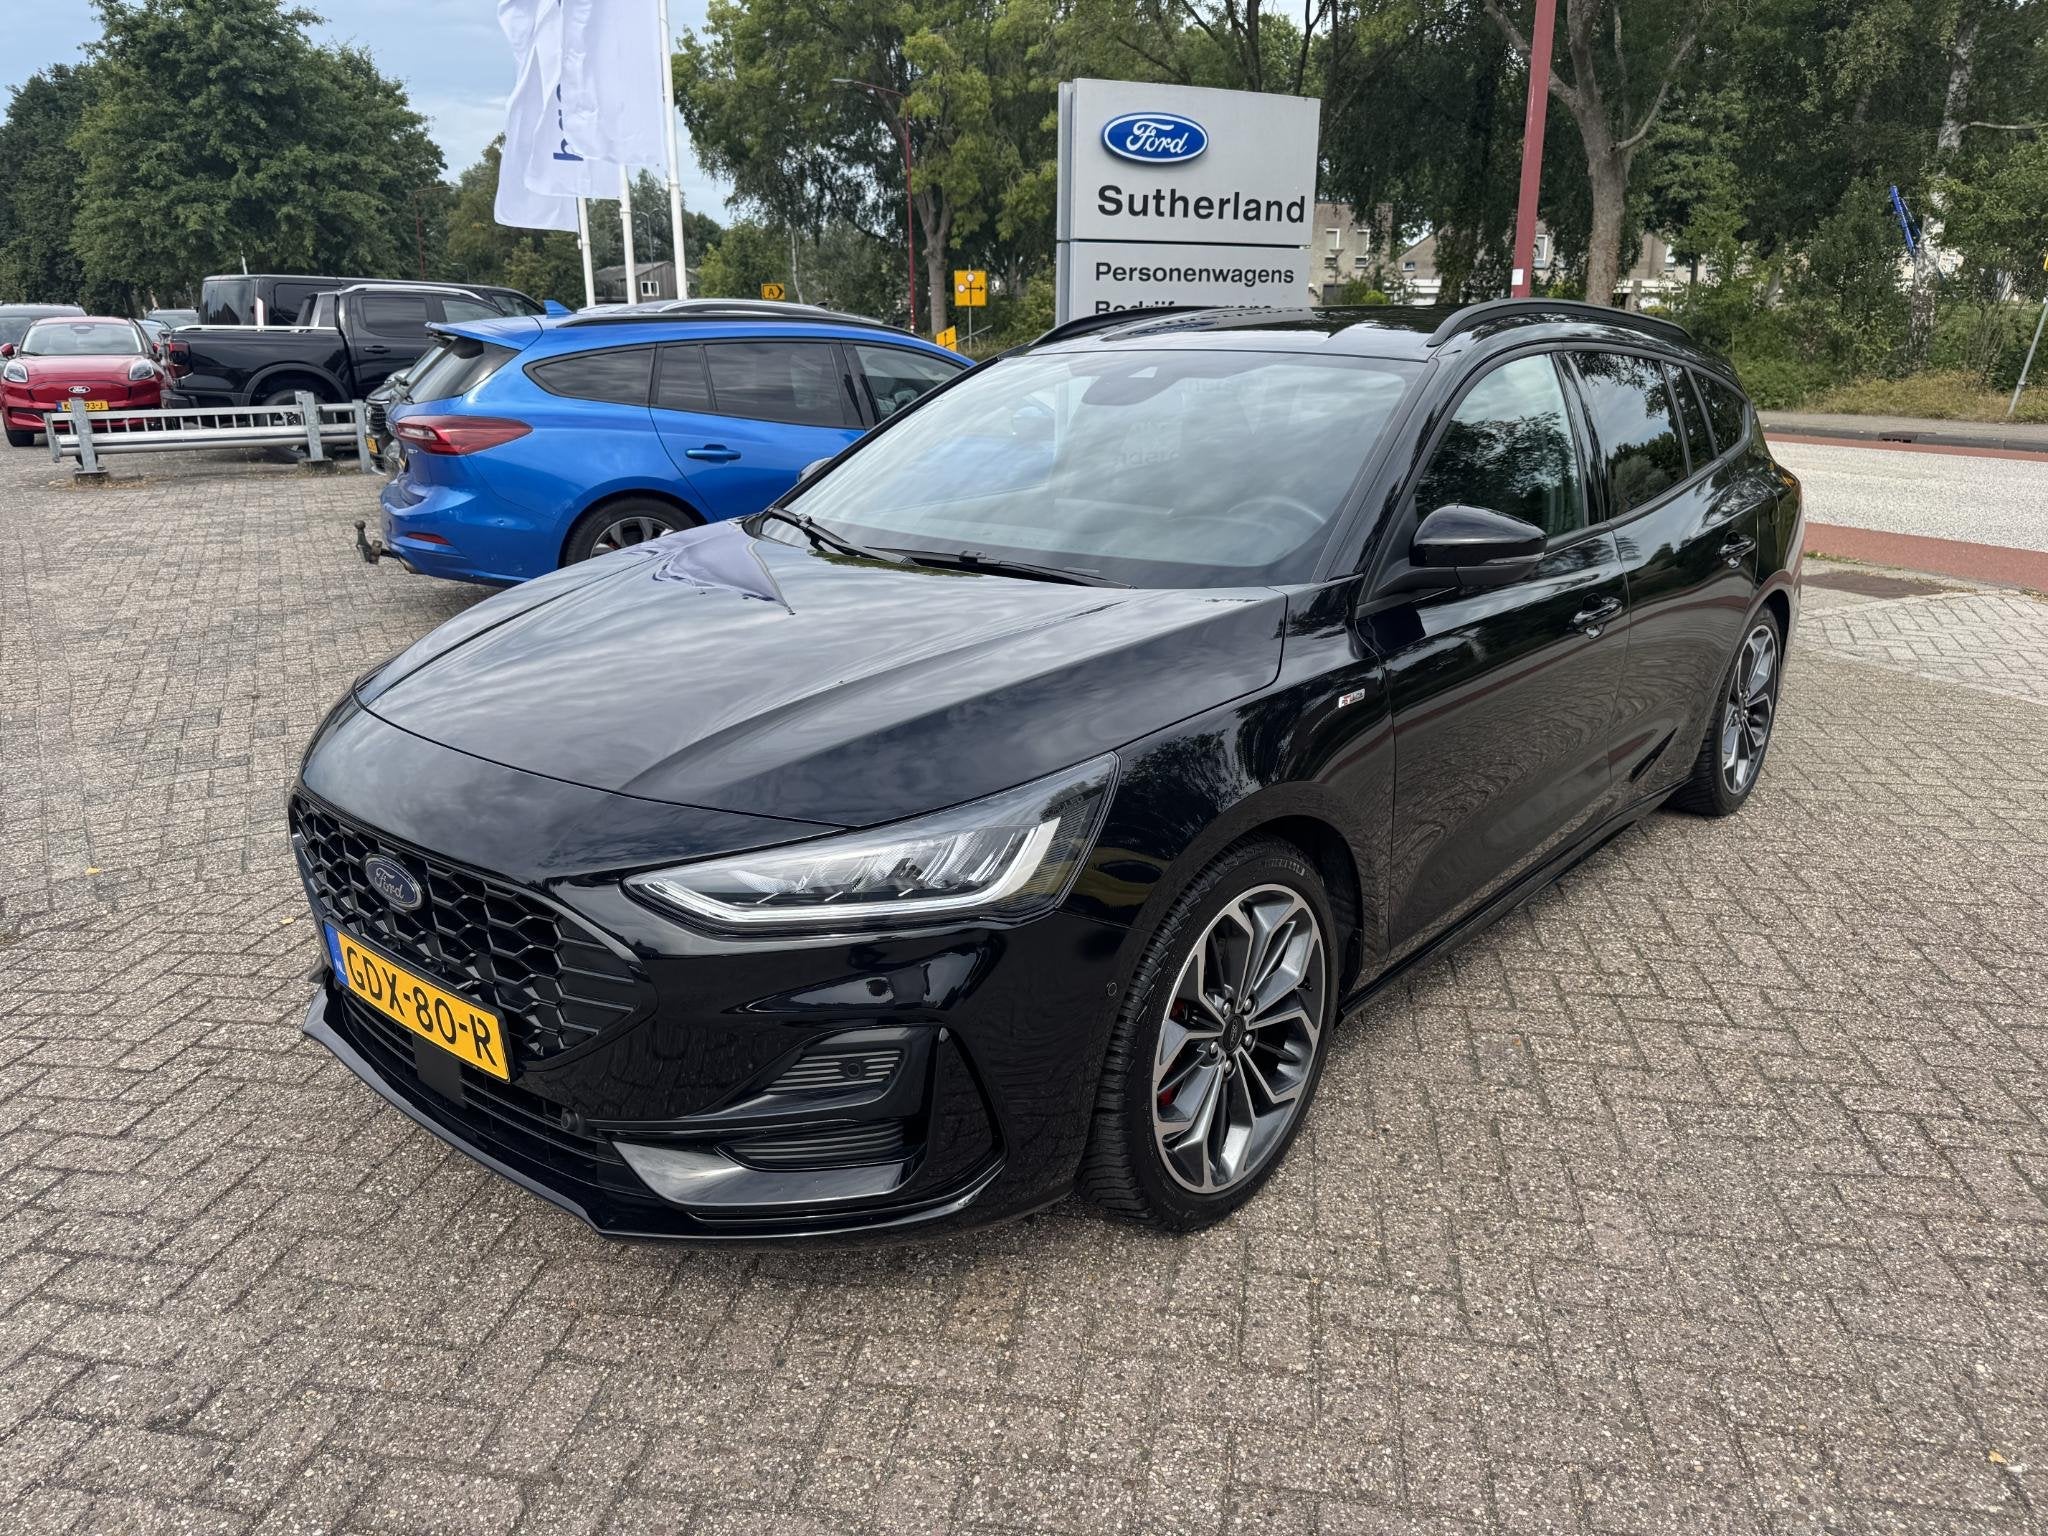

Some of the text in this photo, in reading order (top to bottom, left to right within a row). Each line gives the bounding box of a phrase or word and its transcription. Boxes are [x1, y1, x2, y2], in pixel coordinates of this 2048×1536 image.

[1126, 120, 1189, 154] Ford
[1097, 185, 1305, 223] Sutherland
[1095, 262, 1294, 287] Personenwagens
[375, 867, 405, 901] Ford
[346, 945, 498, 1067] GDX-80-R
